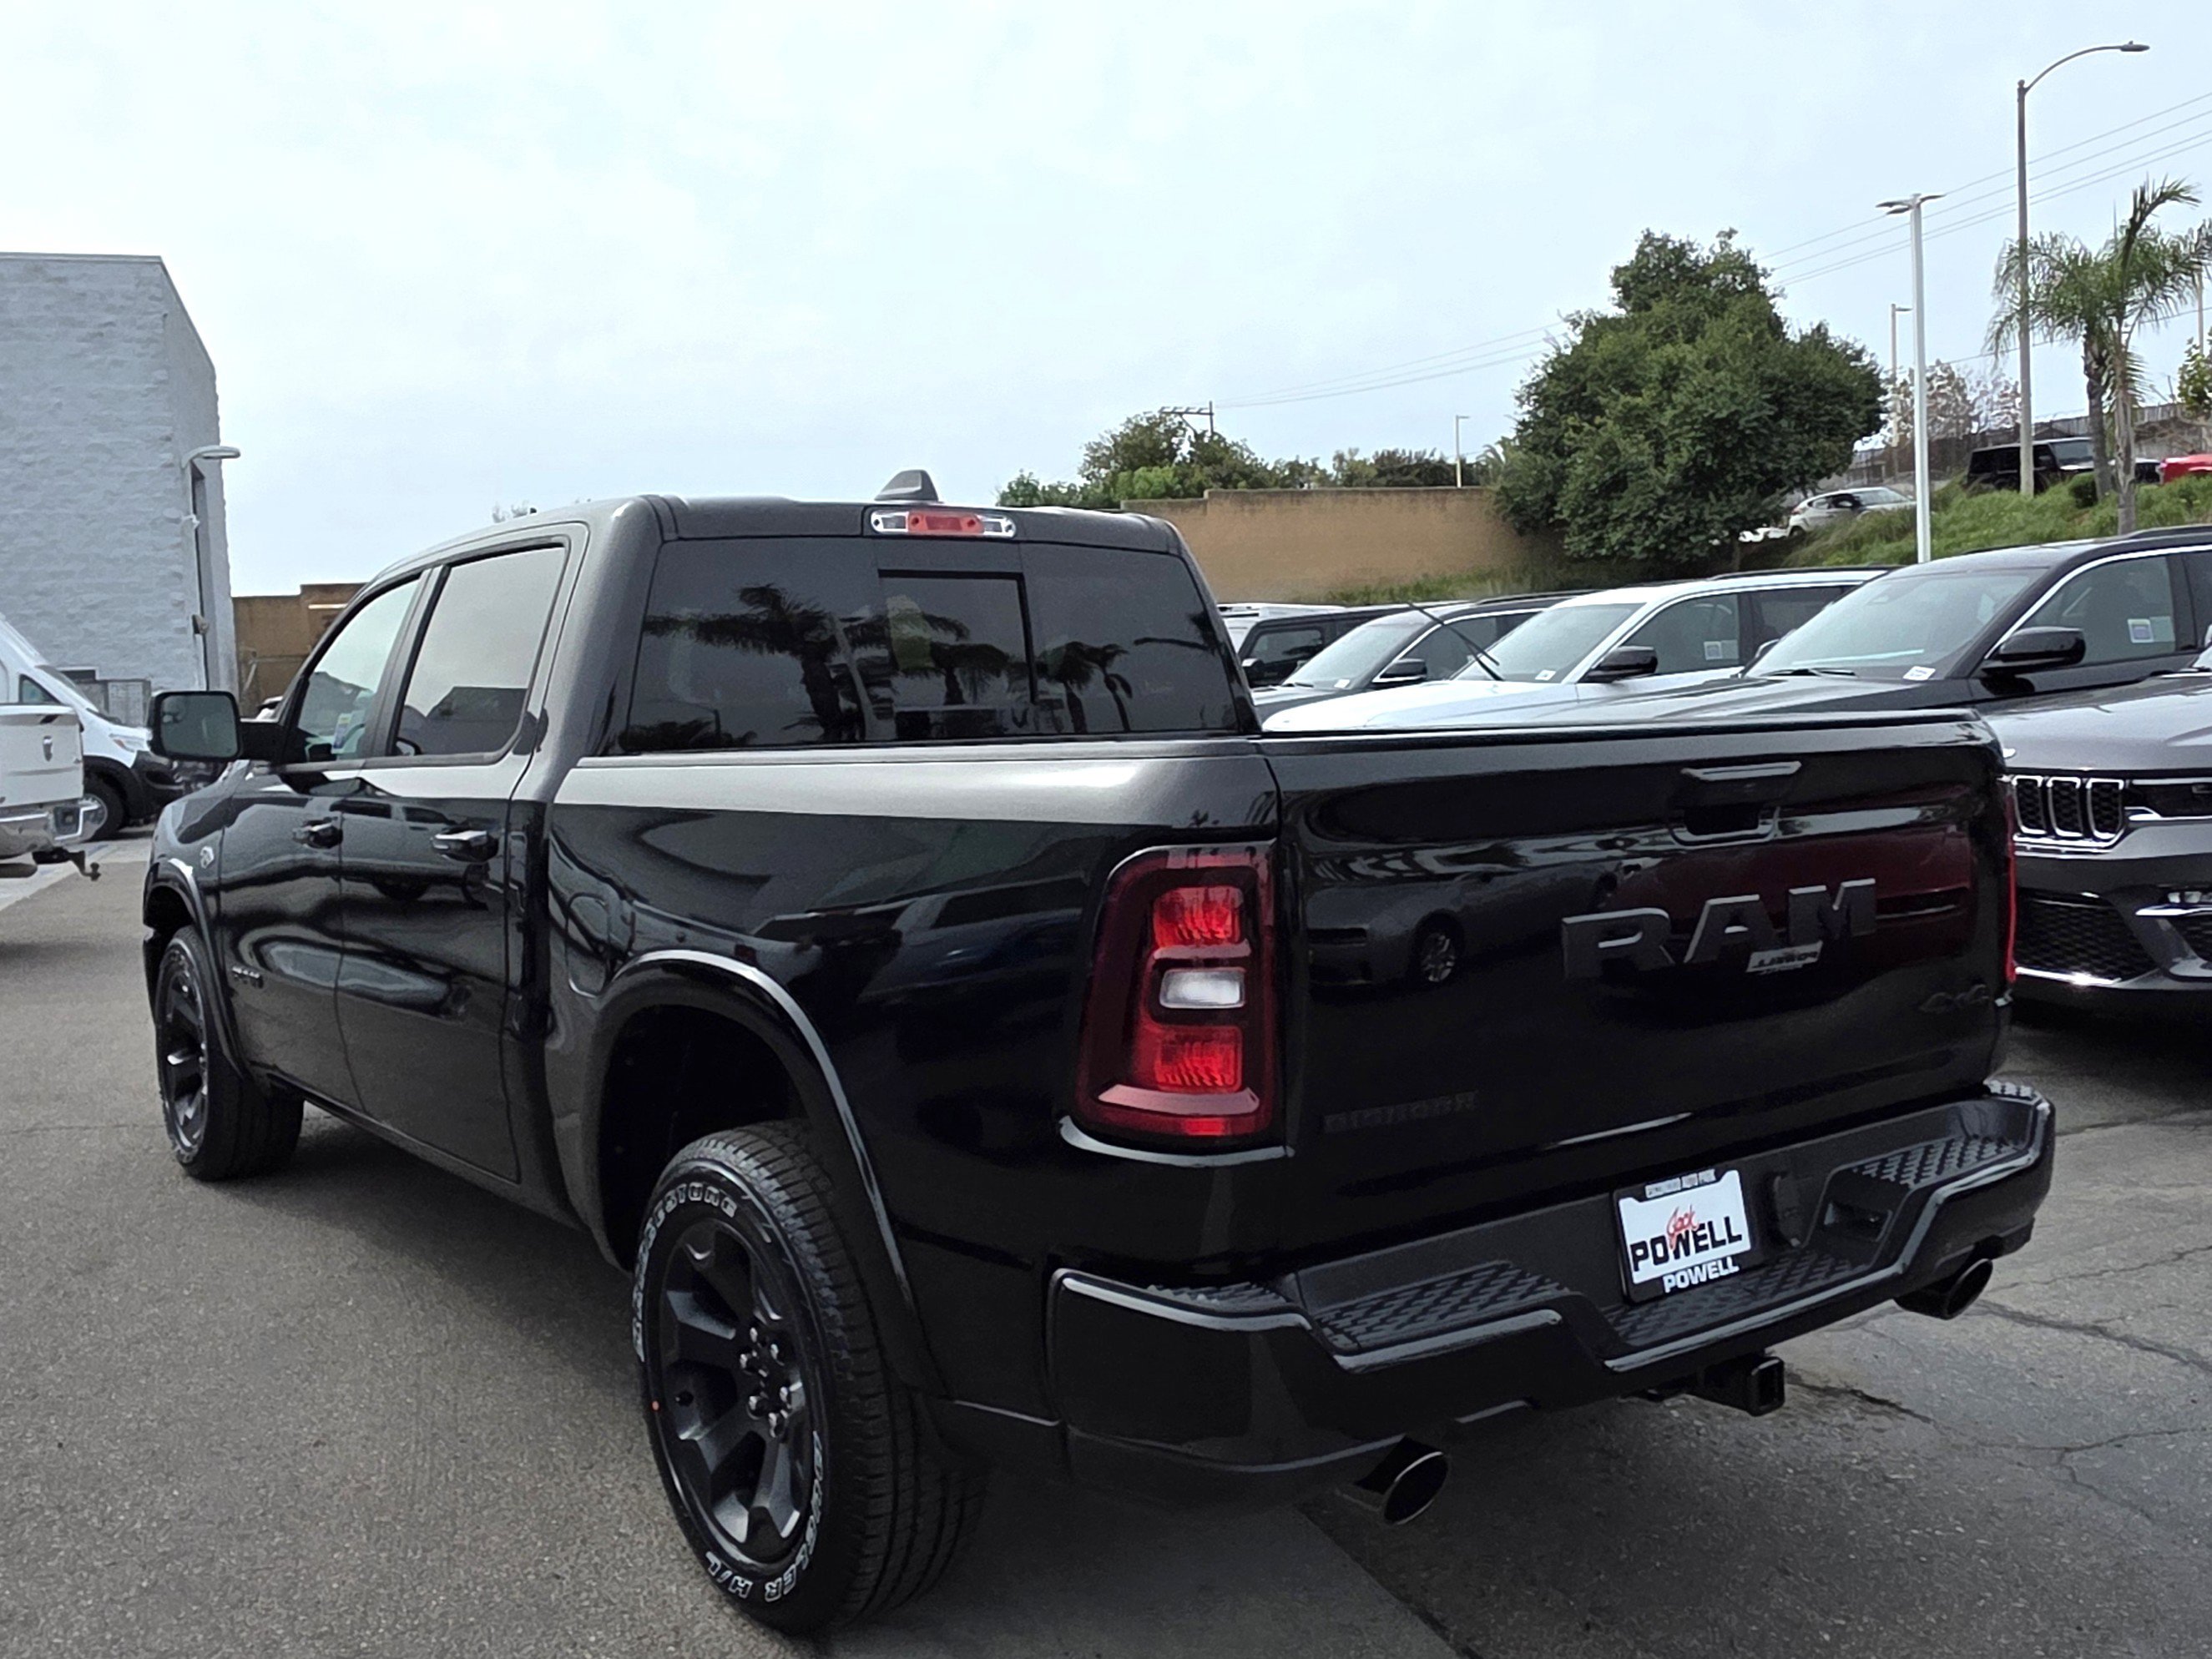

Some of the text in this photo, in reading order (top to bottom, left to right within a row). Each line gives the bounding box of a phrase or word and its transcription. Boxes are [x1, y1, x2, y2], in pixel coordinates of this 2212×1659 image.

[1563, 878, 1876, 983] RAM
[1629, 1216, 1742, 1273] POWELL
[1663, 1256, 1740, 1293] POWELL
